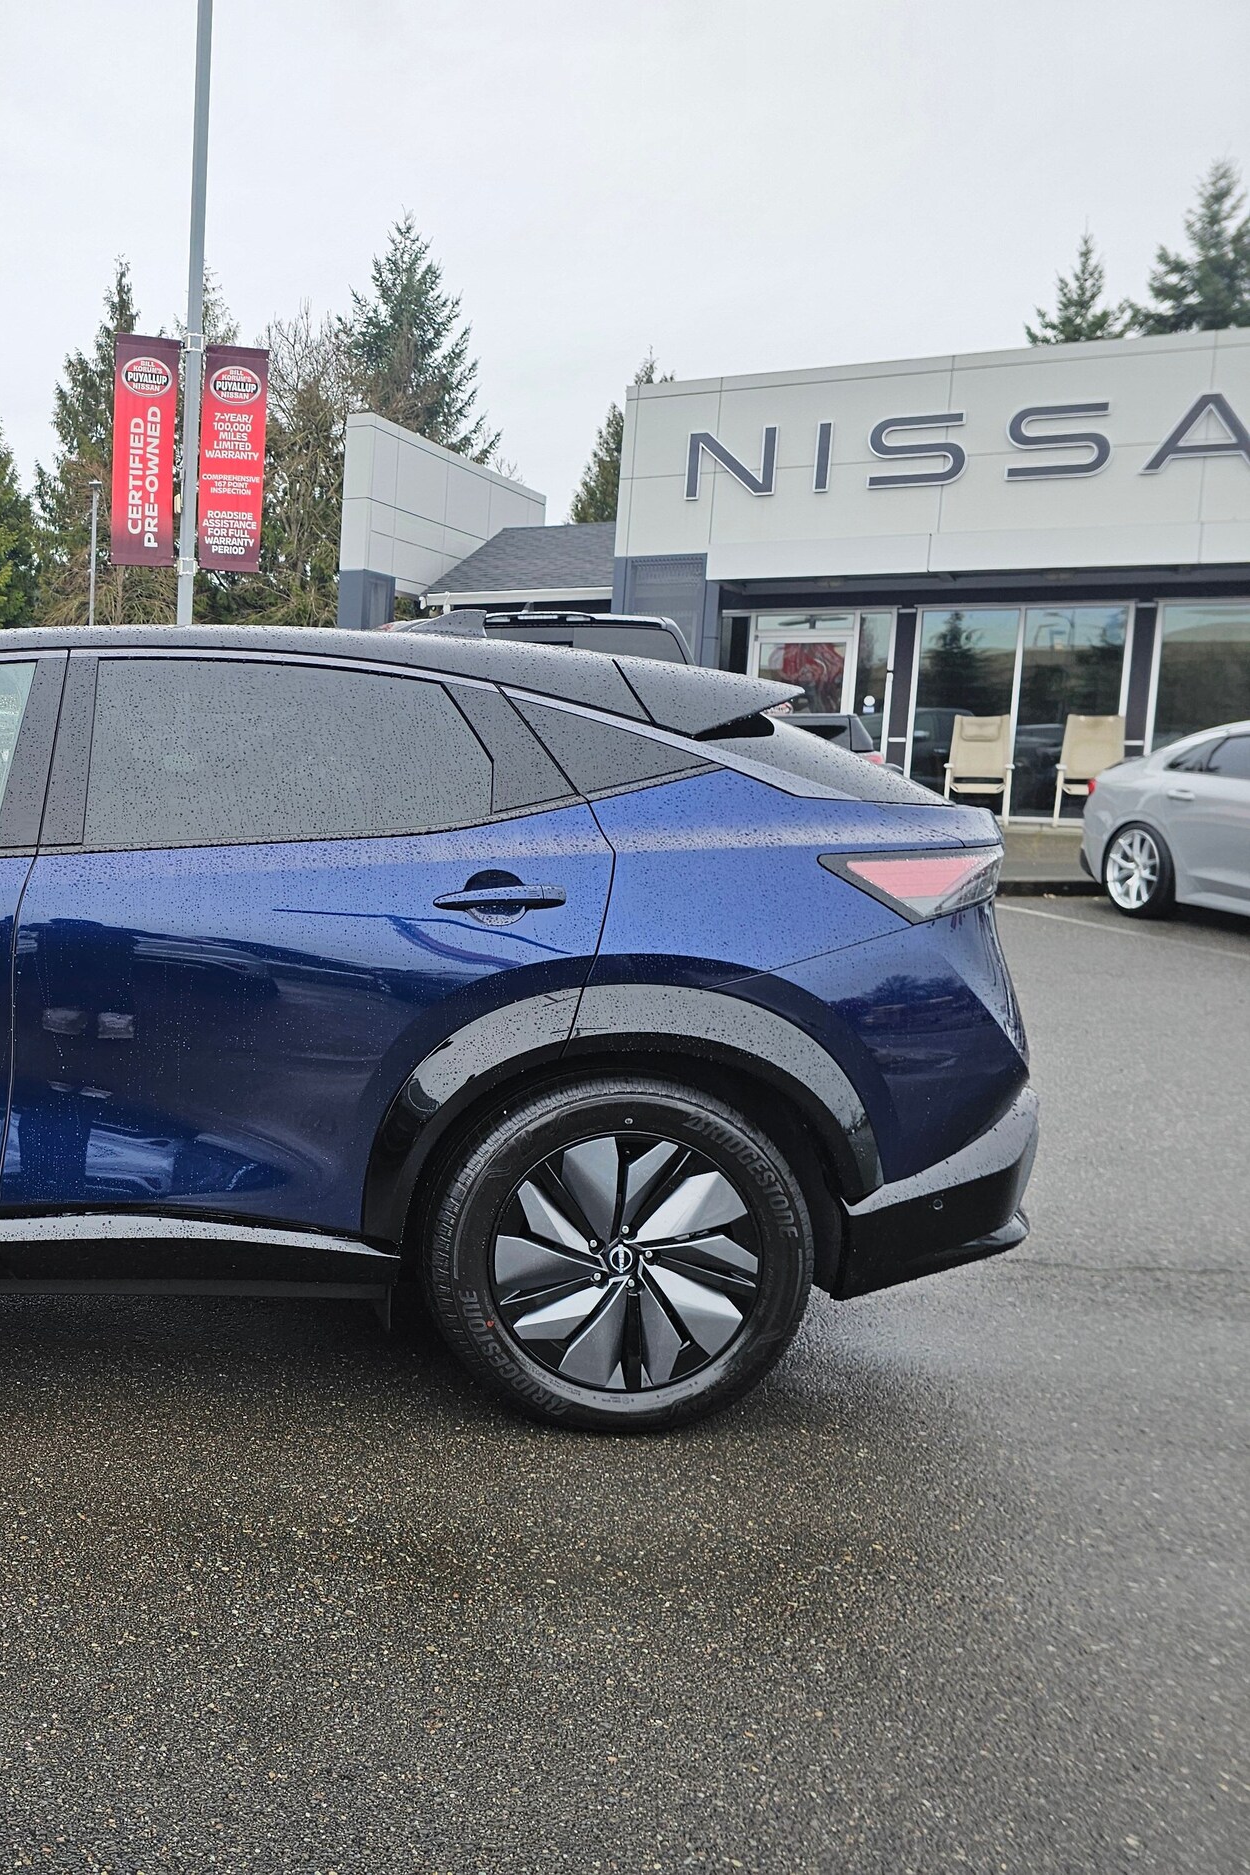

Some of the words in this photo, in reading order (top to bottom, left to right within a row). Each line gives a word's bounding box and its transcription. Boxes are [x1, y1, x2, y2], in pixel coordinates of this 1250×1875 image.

[127, 372, 167, 385] PUYALLUP
[132, 383, 160, 391] NISSAN
[216, 381, 257, 392] PUYALLUP
[220, 391, 249, 399] NISSAN
[214, 412, 253, 424] 7-YEAR/
[213, 422, 252, 433] 100,000
[219, 431, 248, 441] MILES
[213, 440, 252, 451] LIMITED
[205, 449, 259, 461] WARRANTY
[128, 417, 145, 534] CERTIFIED
[144, 406, 162, 548] PRE-OWNED
[202, 473, 260, 483] COMPREHENSIVE
[207, 510, 253, 521] ROADSIDE
[202, 518, 257, 530] ASSISTANCE
[207, 528, 228, 537] FOR
[228, 529, 250, 538] FULL
[204, 536, 255, 548] WARRANTY
[211, 545, 246, 555] PERIOD
[681, 1113, 799, 1239] BRIDGESTONE
[457, 1289, 574, 1417] BRIDGESTONE
